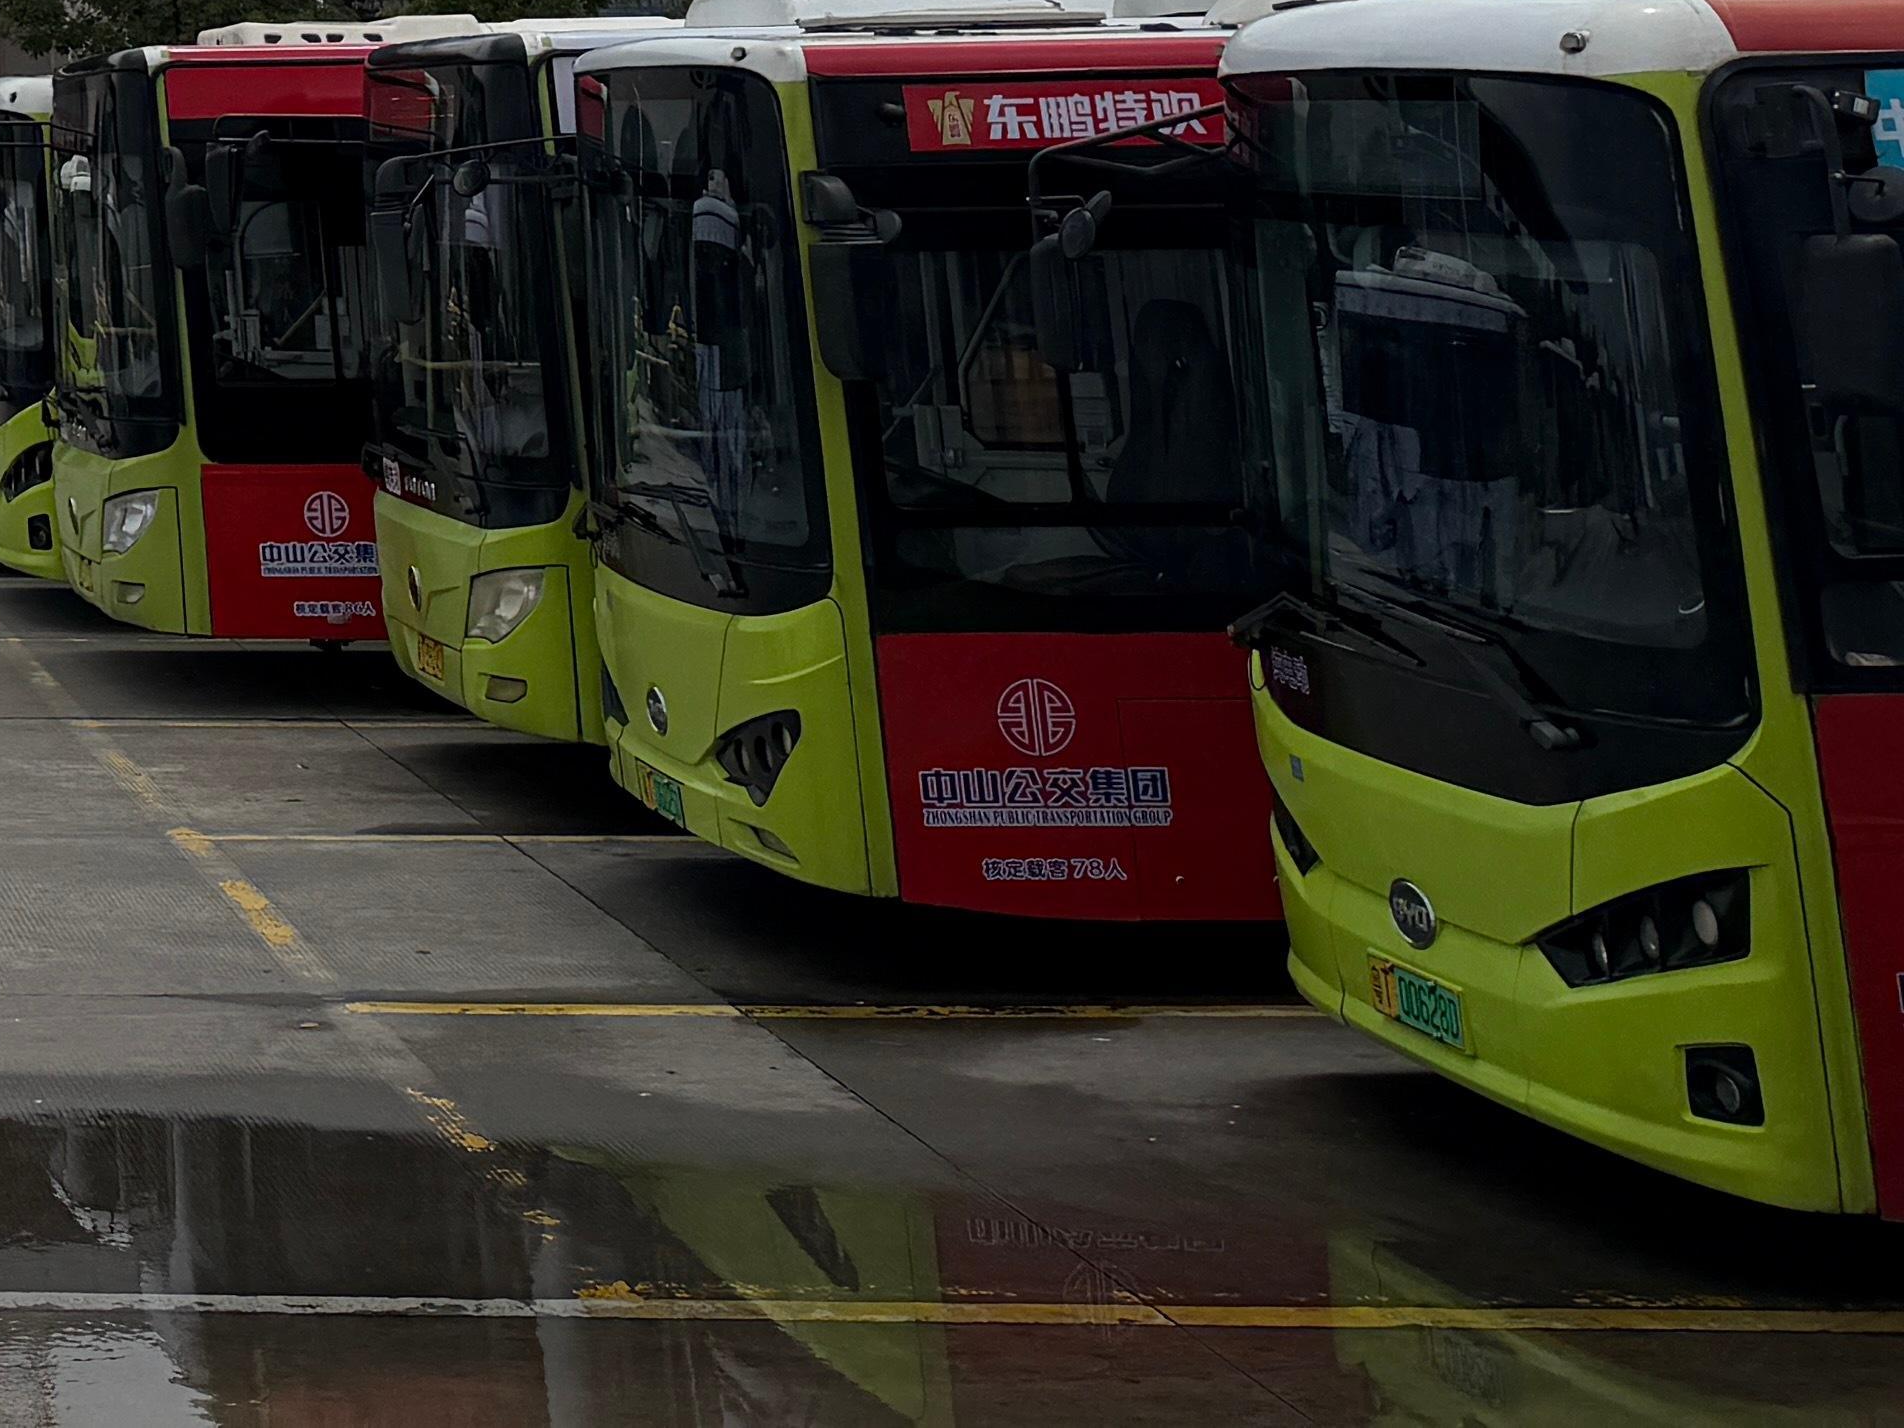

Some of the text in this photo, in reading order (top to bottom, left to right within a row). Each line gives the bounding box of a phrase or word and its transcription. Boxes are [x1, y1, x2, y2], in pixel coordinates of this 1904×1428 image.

[918, 767, 1172, 807] 中山公交集团
[924, 808, 1173, 826] ZHONGSHAN PUBLIC TRANSPORTATION GROUP
